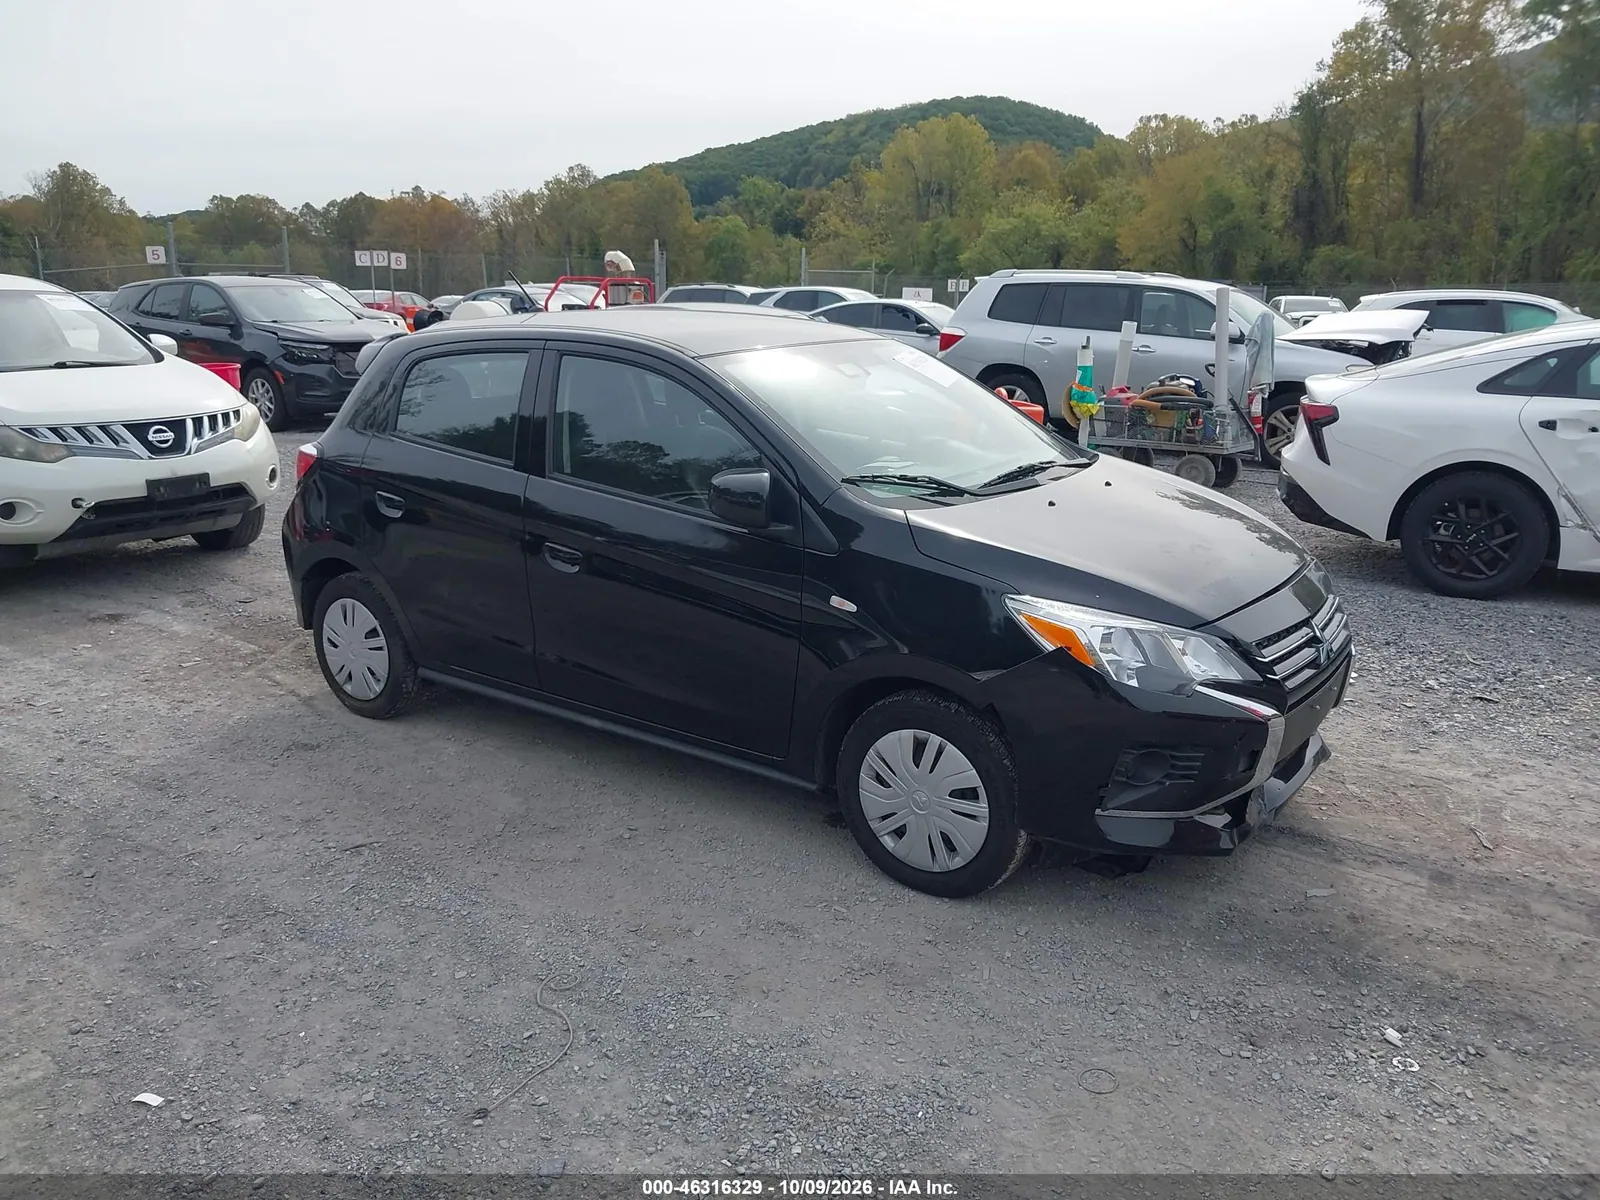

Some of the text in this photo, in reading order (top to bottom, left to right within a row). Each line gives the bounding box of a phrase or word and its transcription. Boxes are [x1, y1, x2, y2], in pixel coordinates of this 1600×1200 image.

[151, 249, 160, 261] 5
[359, 253, 386, 264] C D
[395, 256, 402, 266] 6
